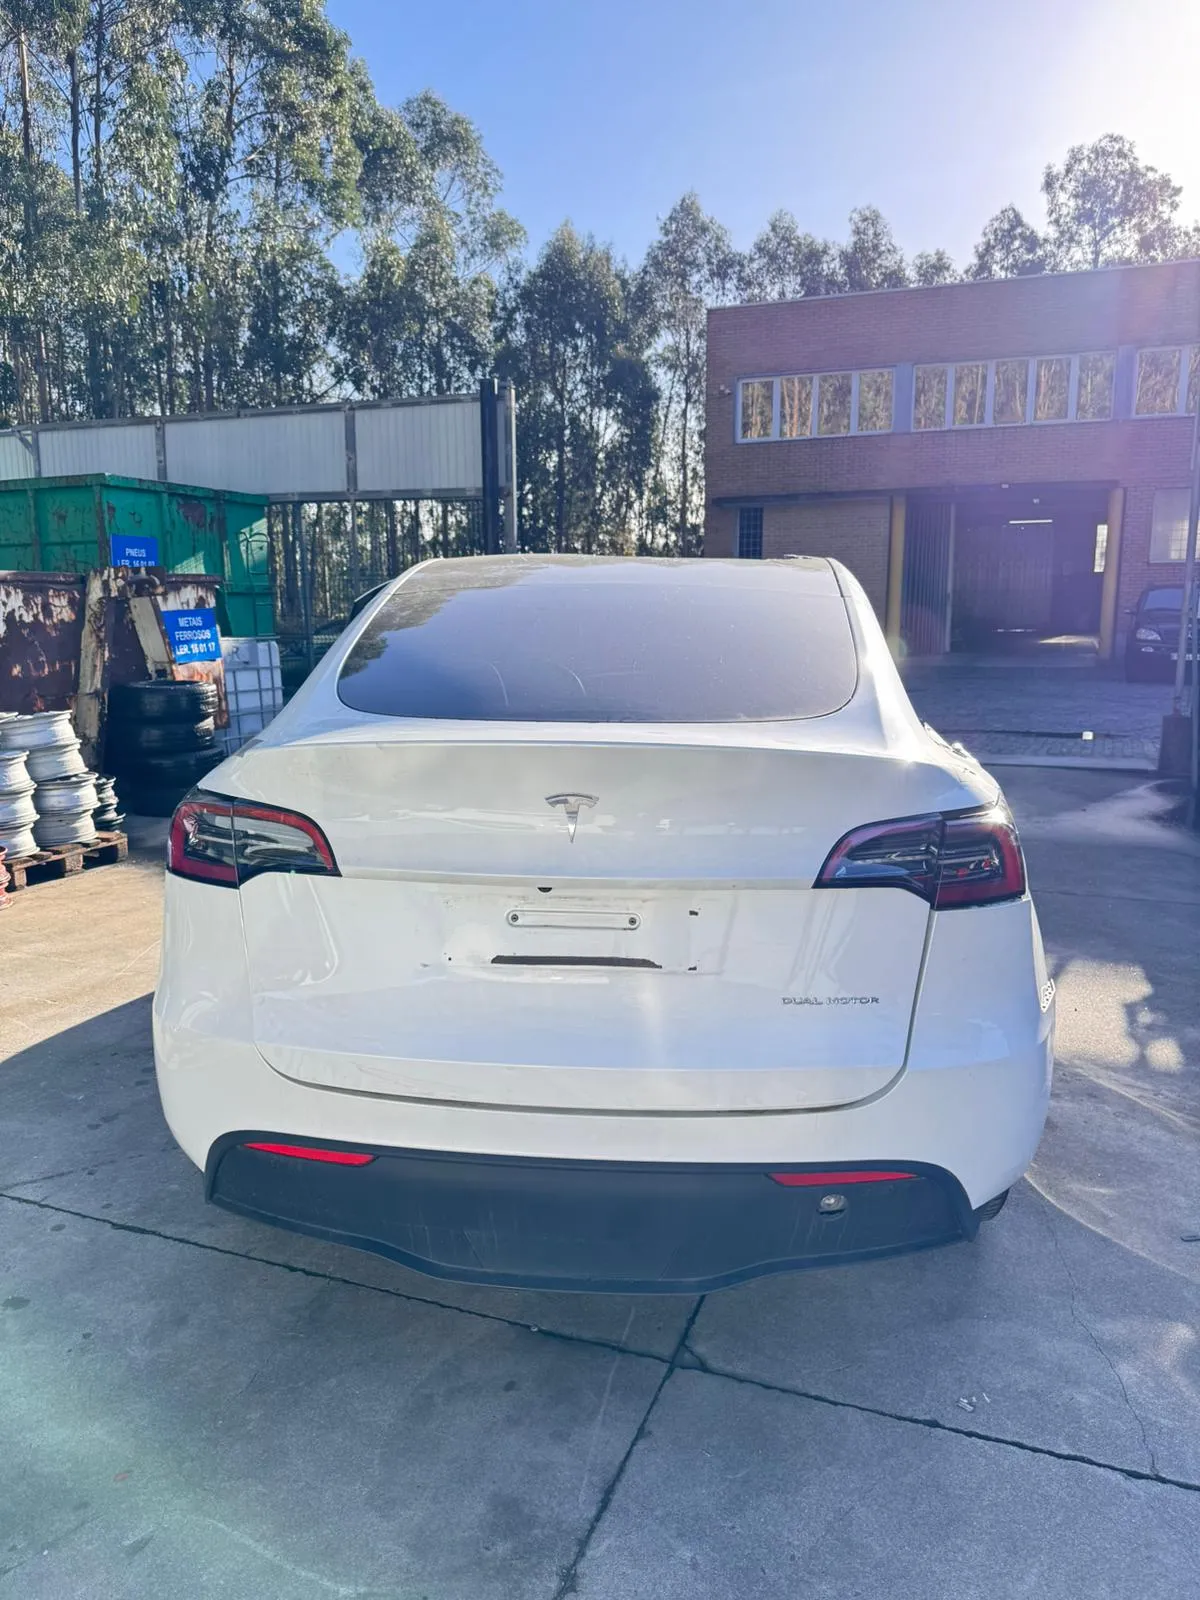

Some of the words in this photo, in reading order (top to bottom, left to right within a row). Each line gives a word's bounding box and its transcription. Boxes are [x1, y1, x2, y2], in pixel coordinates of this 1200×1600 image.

[125, 547, 146, 557] PNEUS
[178, 616, 203, 627] METAIS
[175, 629, 211, 641] FERROSOS
[176, 643, 190, 655] LER.
[208, 641, 215, 652] 17
[781, 996, 823, 1006] DUAL
[826, 996, 880, 1006] MOTOR
